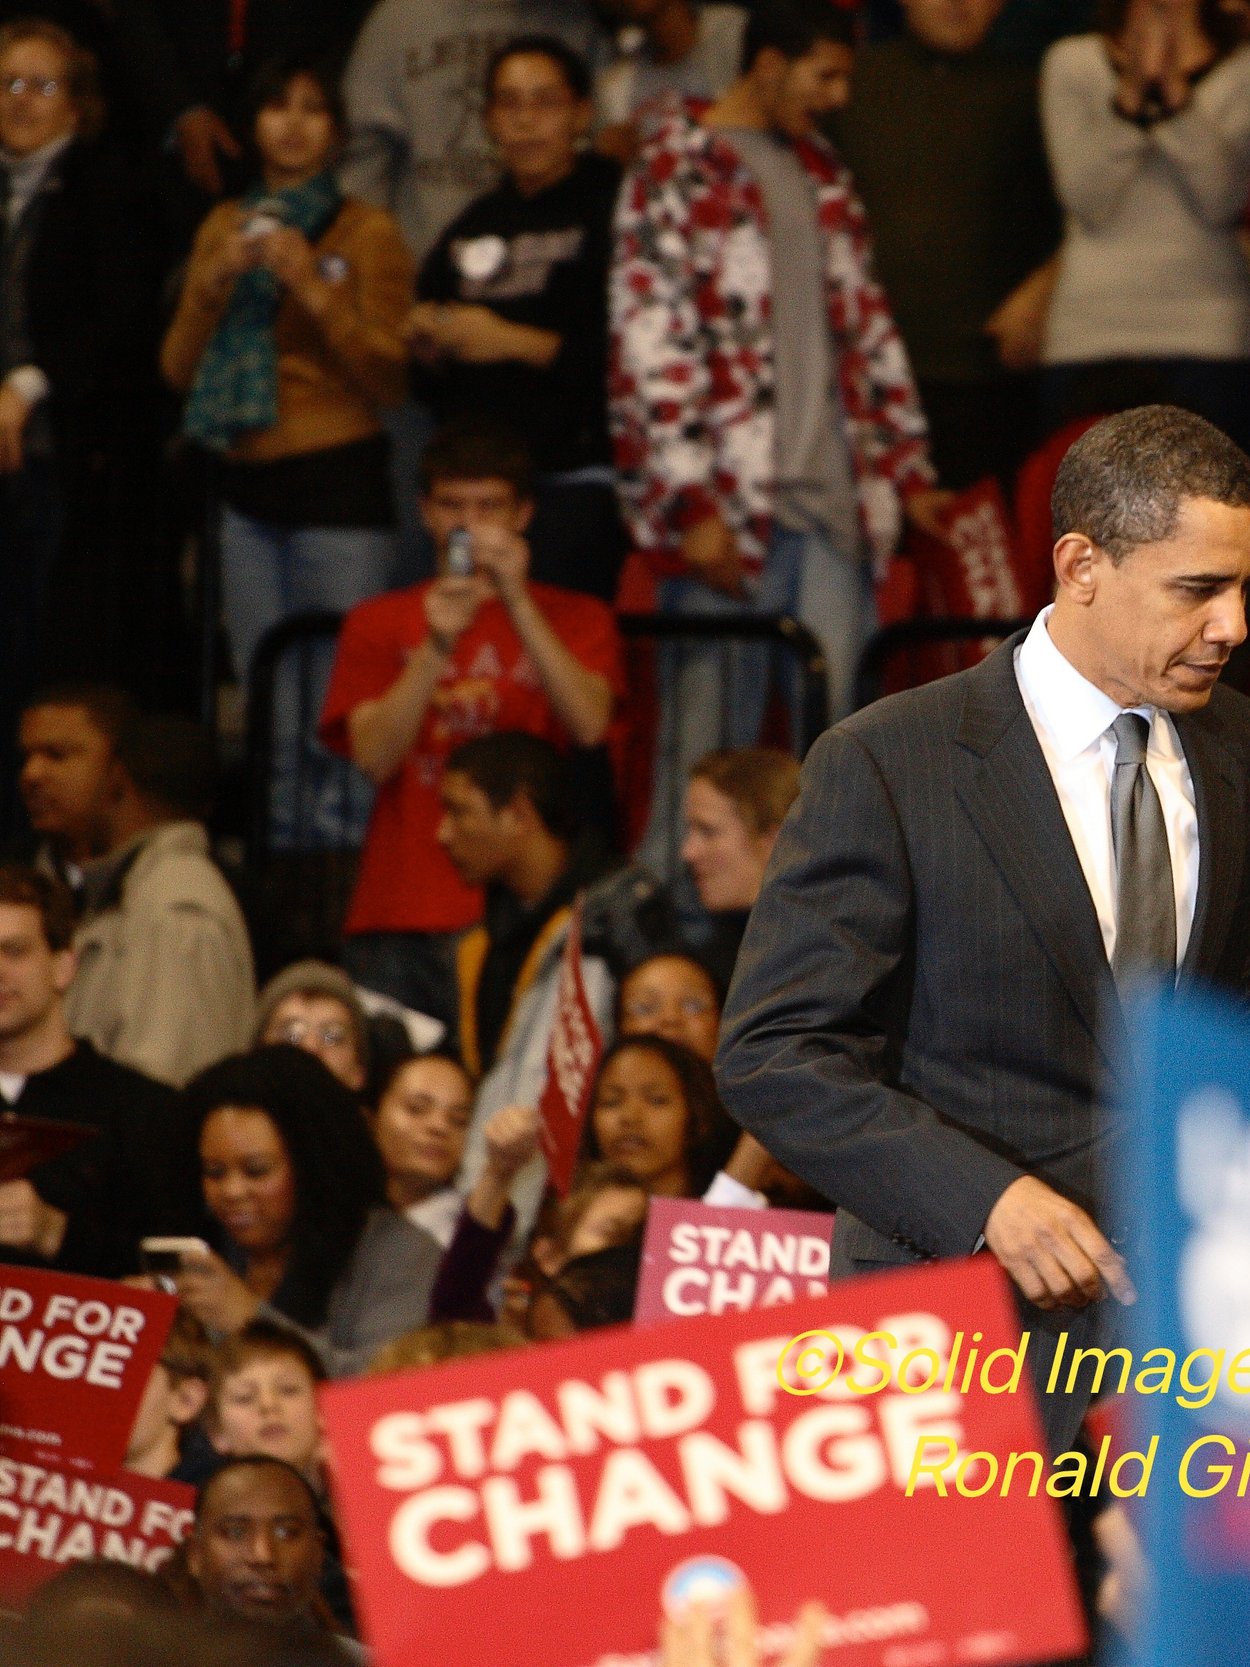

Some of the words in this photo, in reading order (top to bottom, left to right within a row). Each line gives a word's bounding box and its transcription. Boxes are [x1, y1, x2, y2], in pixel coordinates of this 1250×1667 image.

[668, 1222, 831, 1278] STAND
[42, 1294, 146, 1343] FOR
[368, 1356, 716, 1490] STAND
[732, 1311, 956, 1414] FOR
[387, 1388, 974, 1588] CHANGE
